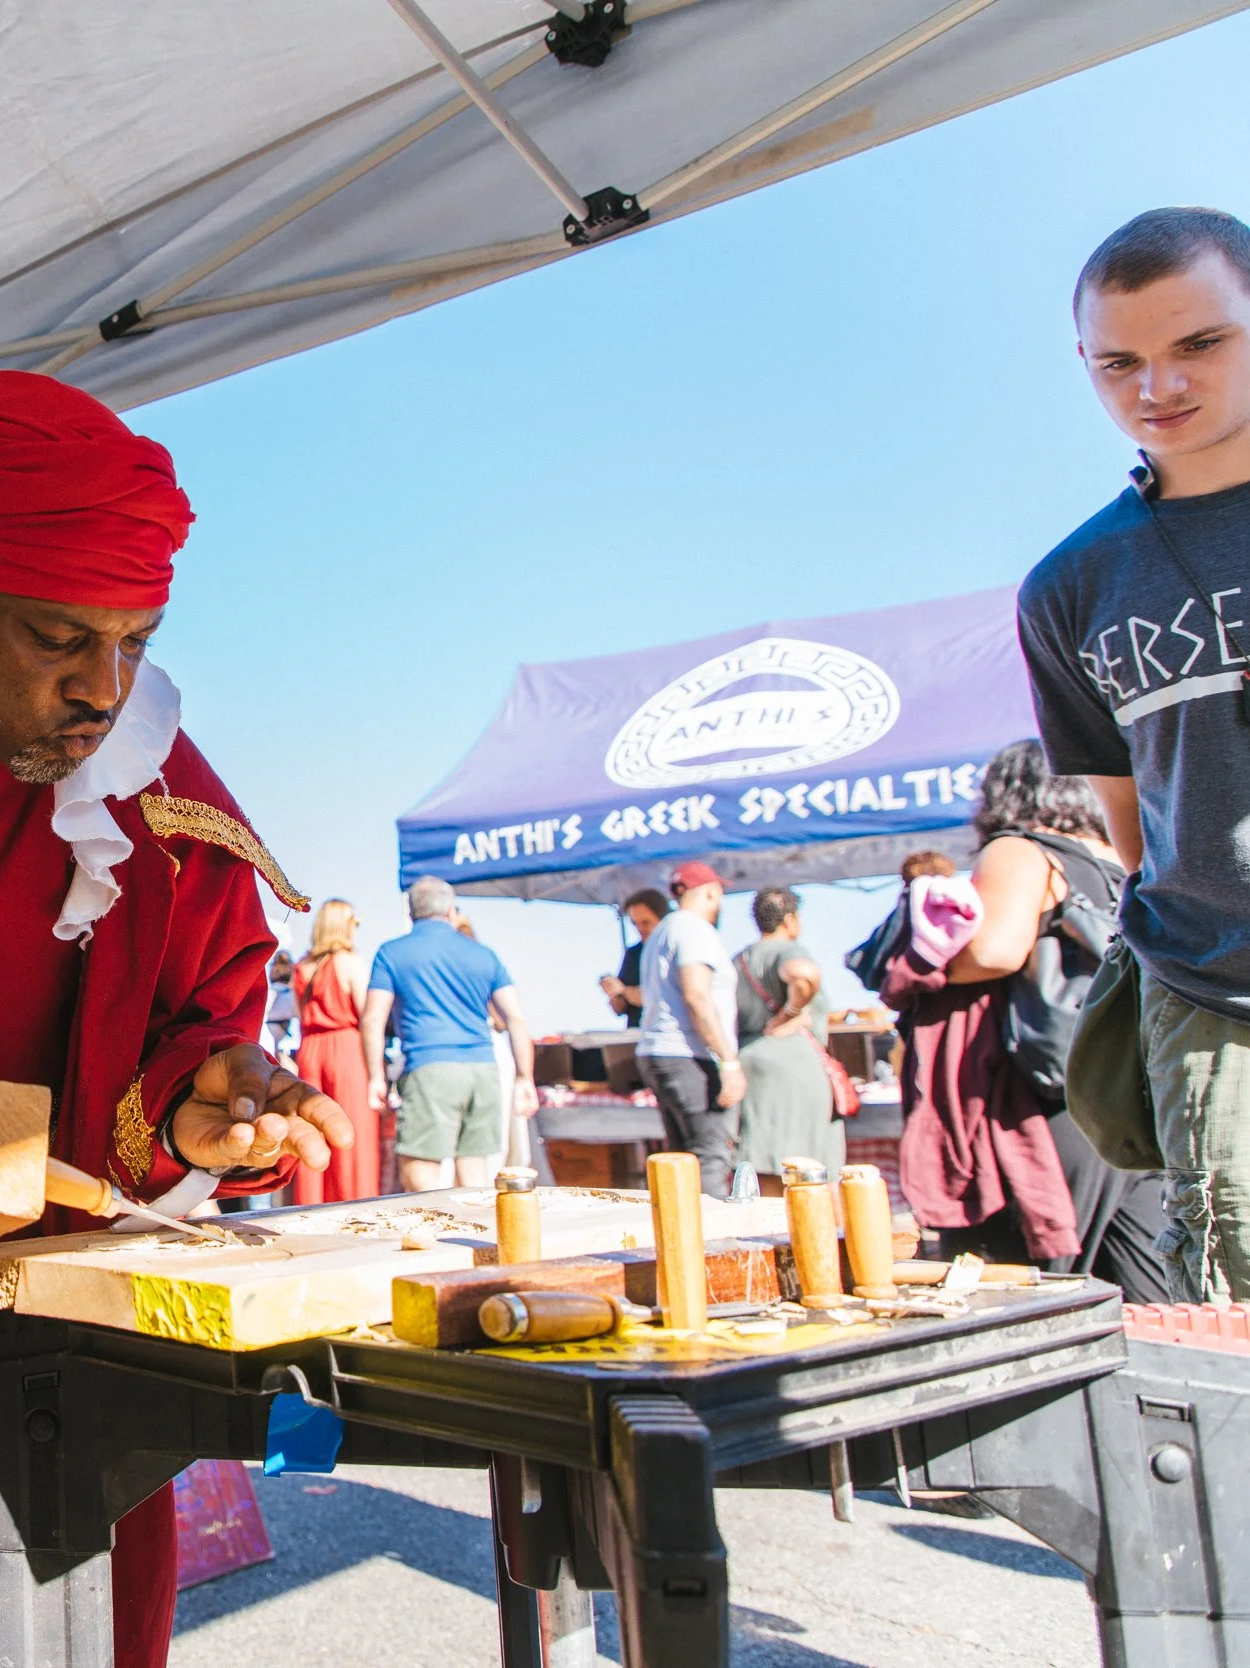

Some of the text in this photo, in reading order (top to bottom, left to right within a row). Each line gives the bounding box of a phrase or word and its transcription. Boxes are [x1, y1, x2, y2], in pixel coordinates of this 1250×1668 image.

[665, 706, 833, 743] ANTHIS
[453, 813, 582, 865] ANTHI'S
[600, 793, 720, 842] GREEK
